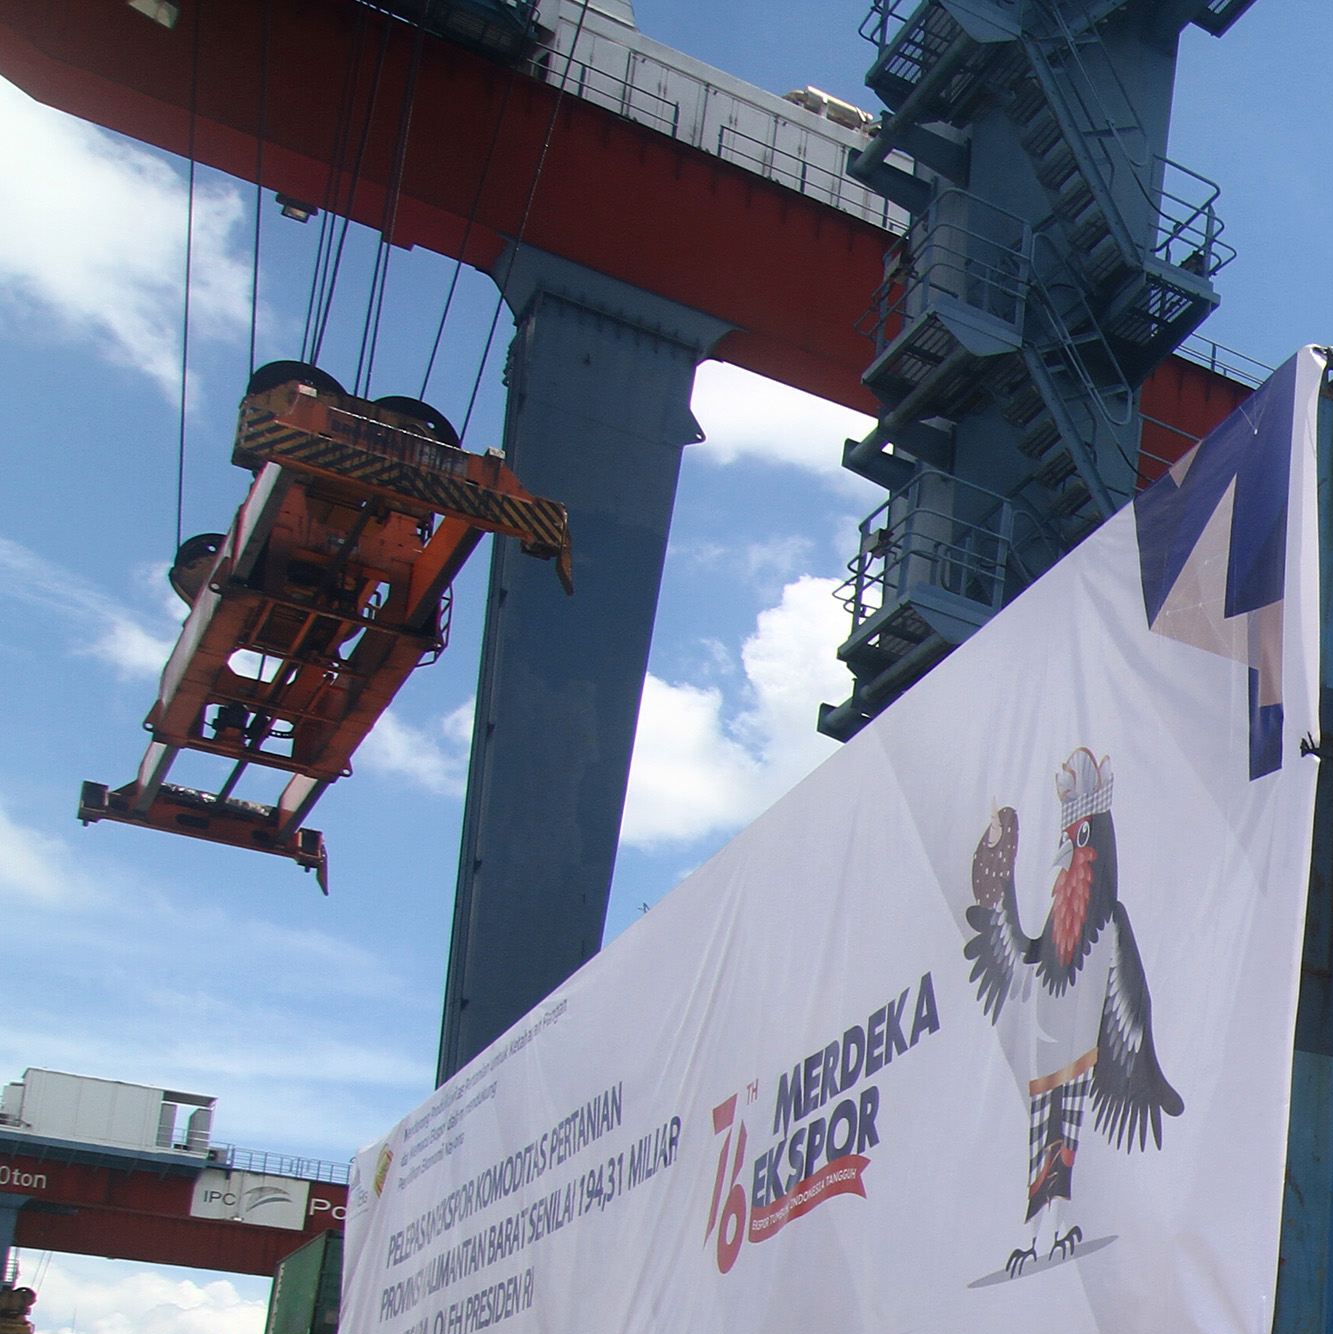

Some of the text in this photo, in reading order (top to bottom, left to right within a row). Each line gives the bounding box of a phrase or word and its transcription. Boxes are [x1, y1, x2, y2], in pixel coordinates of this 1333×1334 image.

[746, 1078, 759, 1106] TH
[772, 970, 941, 1138] MERDEKA
[474, 1132, 550, 1210] KOMODITAS
[549, 1080, 623, 1171] PERTANIAN
[752, 1085, 880, 1208] EKSPOR
[825, 1168, 857, 1188] TANGGUH
[203, 1189, 237, 1207] IPC
[487, 1206, 529, 1266] BARAT
[528, 1178, 577, 1245] SENILAI
[577, 1151, 625, 1218] 194,31
[627, 1115, 682, 1191] MILIAR
[521, 1265, 535, 1311] RI
